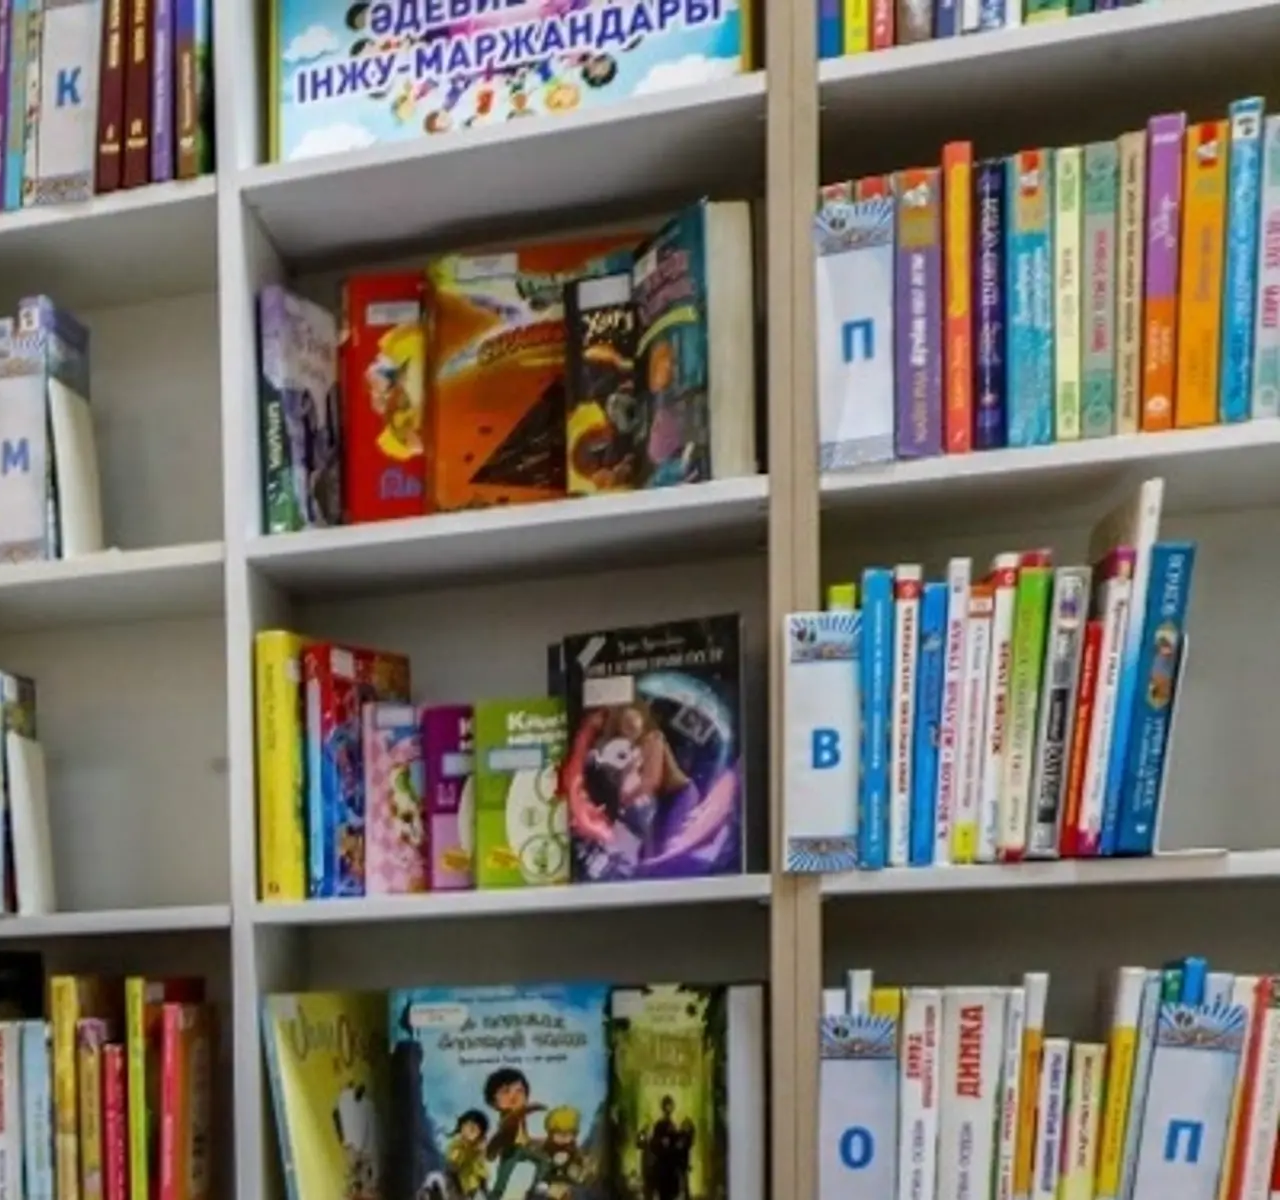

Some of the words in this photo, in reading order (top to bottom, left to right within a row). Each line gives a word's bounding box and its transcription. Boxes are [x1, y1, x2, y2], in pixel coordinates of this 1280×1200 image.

[56, 68, 82, 104] К
[841, 317, 878, 362] П
[1, 437, 30, 473] М
[809, 725, 845, 771] В
[954, 1003, 987, 1099] ДИНКА
[838, 1127, 877, 1171] О
[1163, 1117, 1207, 1165] П
